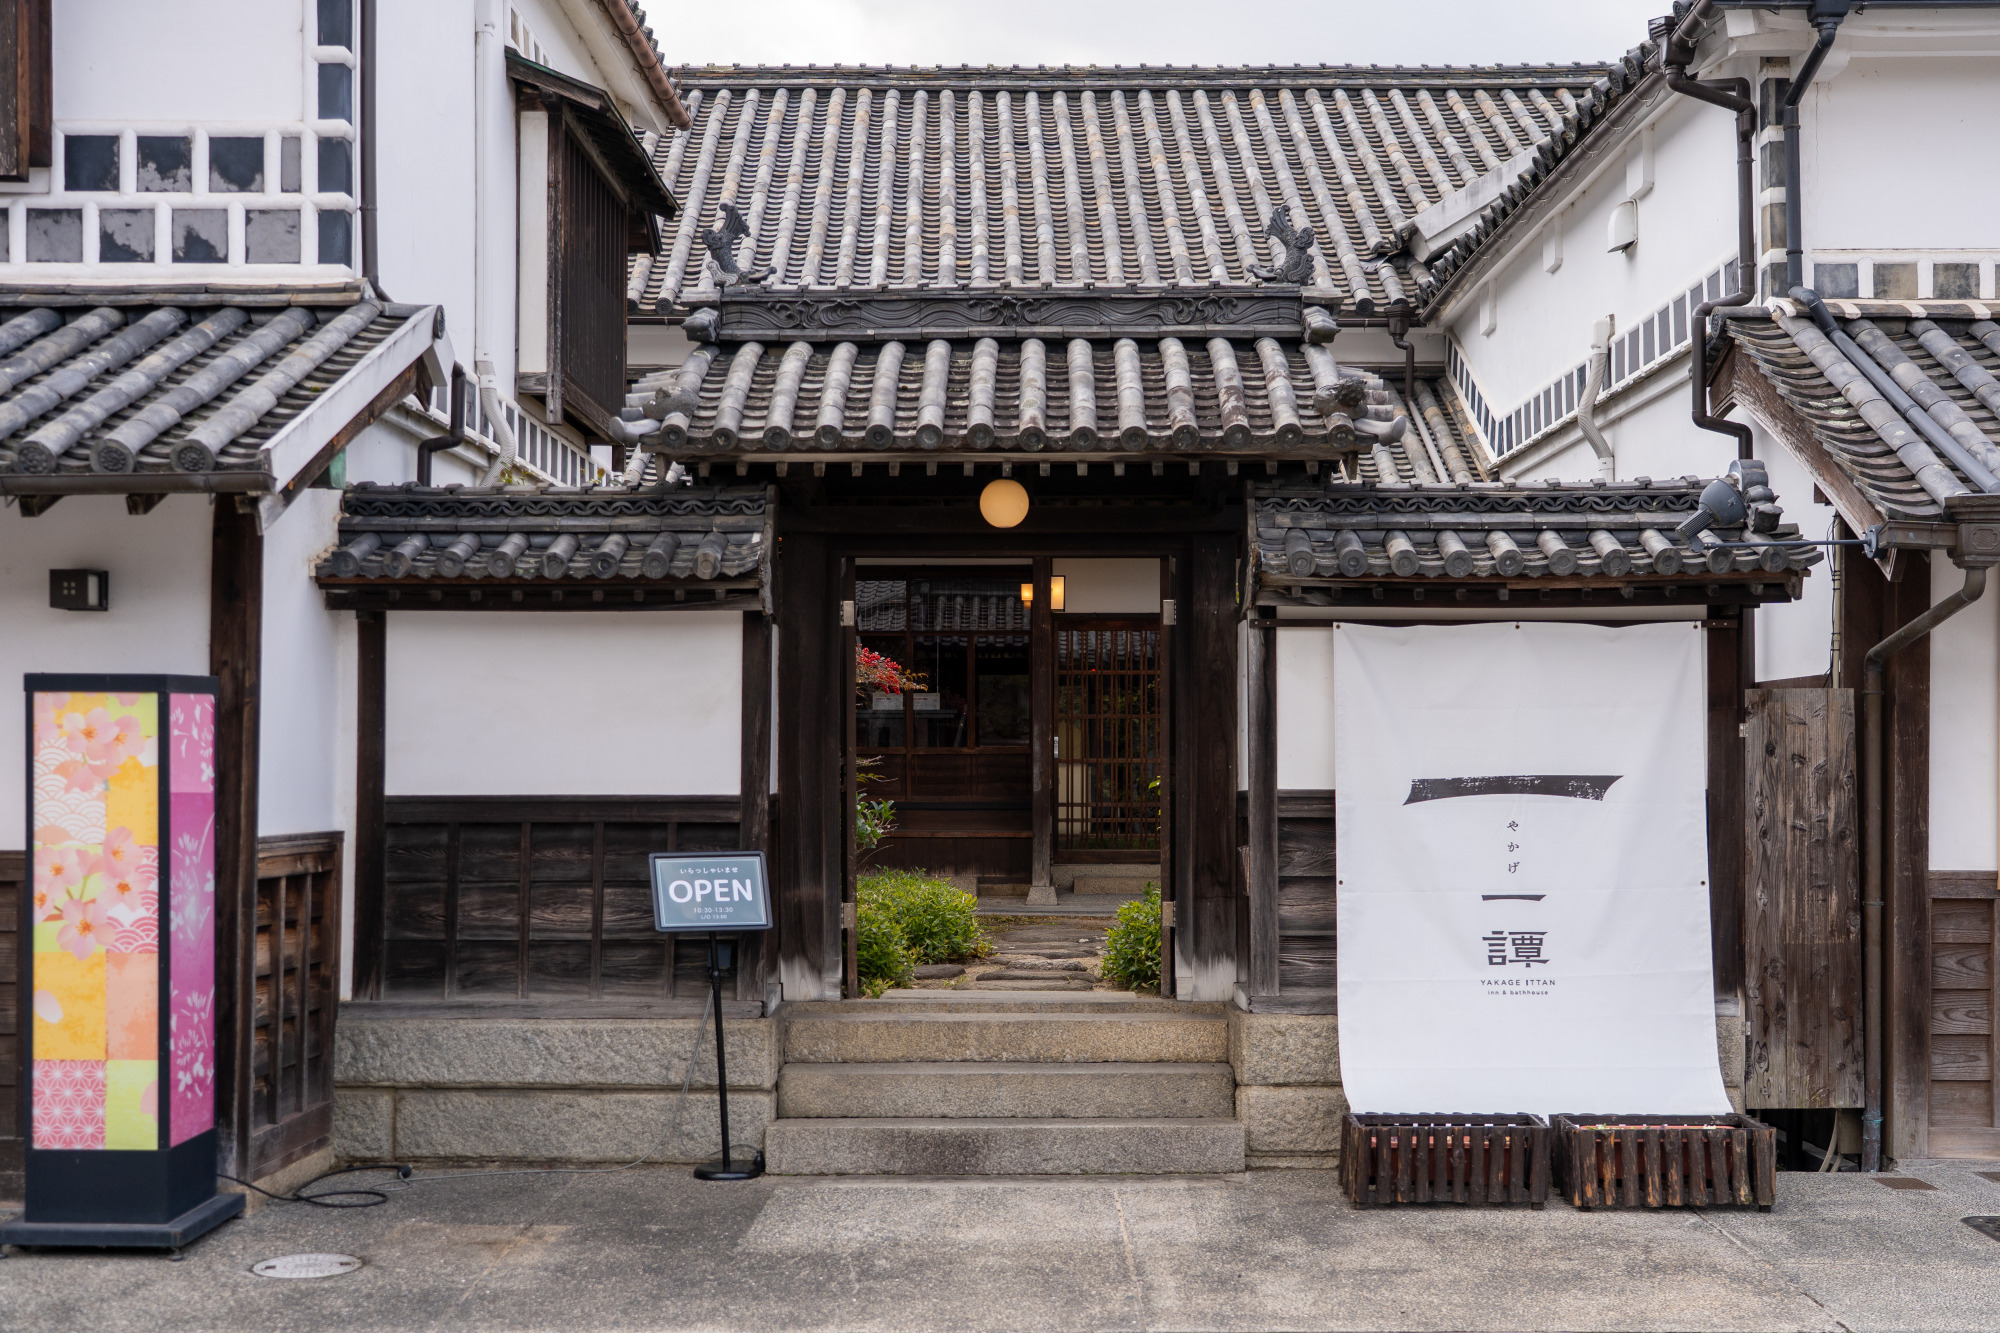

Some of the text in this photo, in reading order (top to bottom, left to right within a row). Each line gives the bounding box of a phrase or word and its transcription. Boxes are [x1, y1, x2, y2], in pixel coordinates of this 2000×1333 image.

[1507, 820, 1520, 873] やかげ
[680, 866, 739, 874] いらっしゃいませ
[669, 878, 753, 903] OPEN
